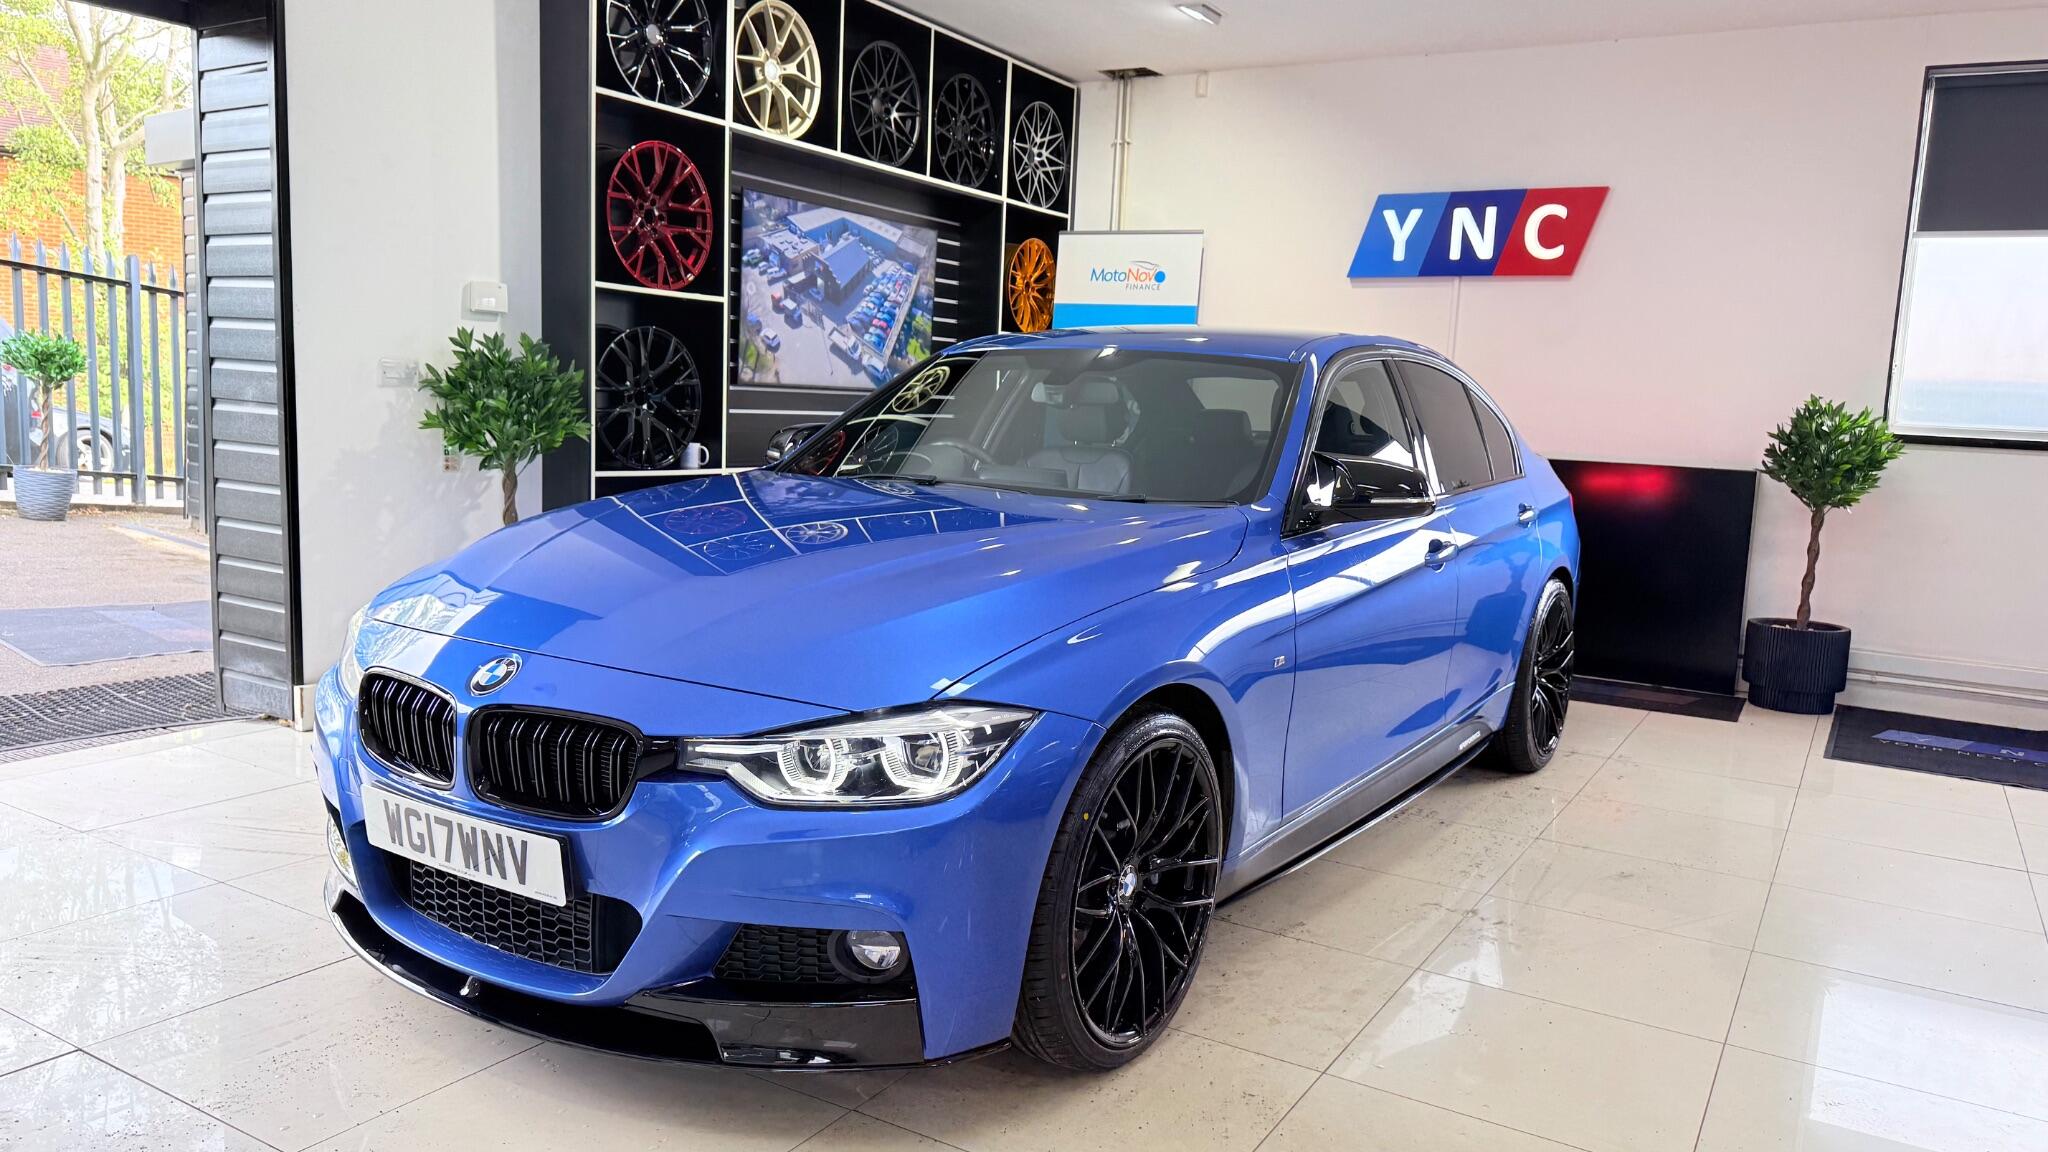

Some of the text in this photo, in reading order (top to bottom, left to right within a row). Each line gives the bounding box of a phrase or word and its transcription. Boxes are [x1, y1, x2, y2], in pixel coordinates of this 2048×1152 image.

[1382, 203, 1568, 262] YNC
[1125, 283, 1161, 291] FINANCE
[1879, 739, 1944, 752] YOUR
[1957, 750, 2021, 764] NEXT
[383, 799, 528, 886] WG17WNV
